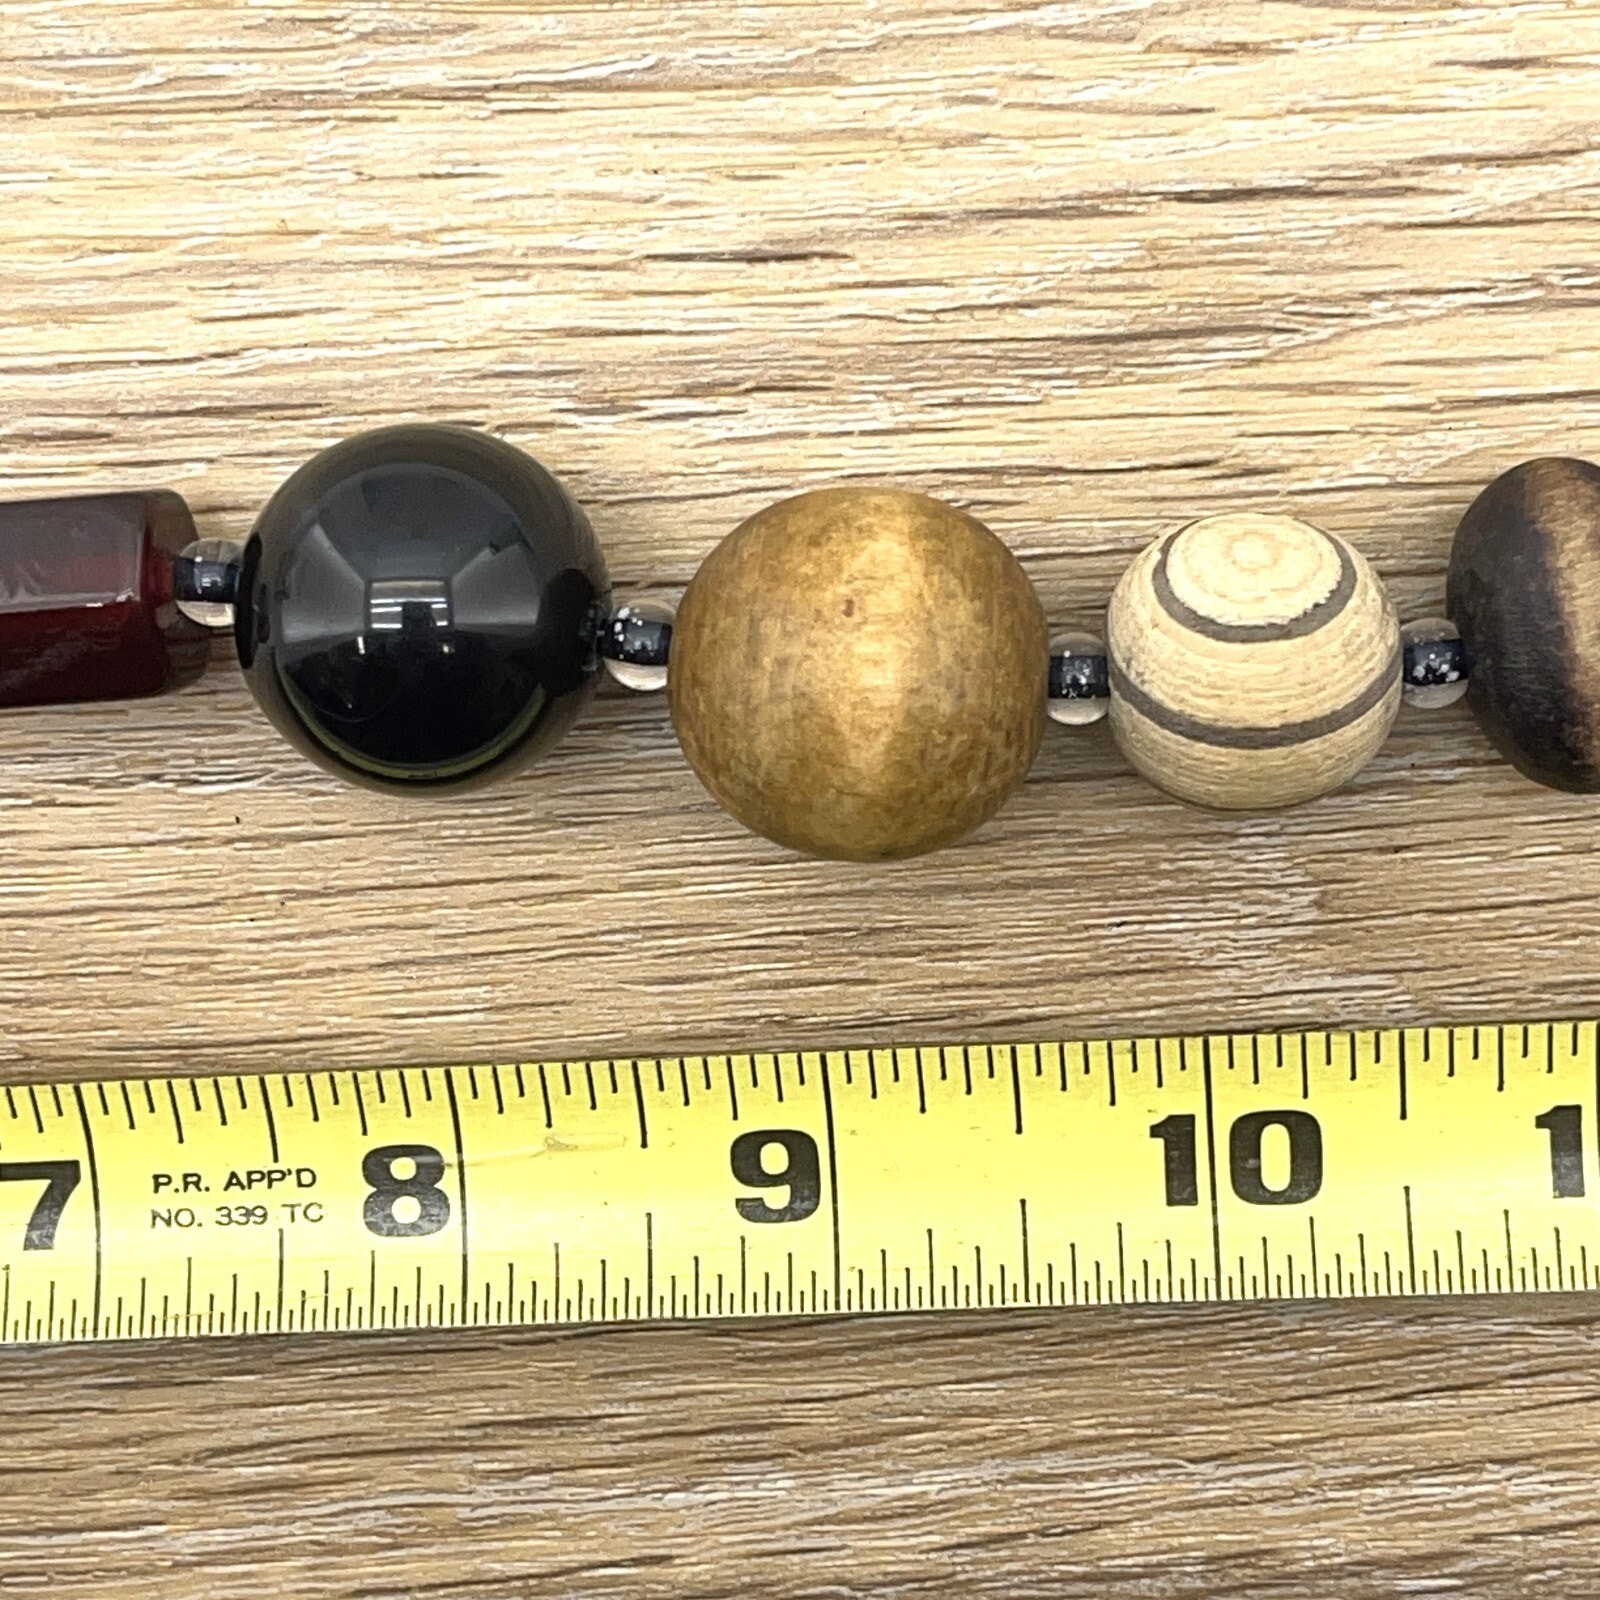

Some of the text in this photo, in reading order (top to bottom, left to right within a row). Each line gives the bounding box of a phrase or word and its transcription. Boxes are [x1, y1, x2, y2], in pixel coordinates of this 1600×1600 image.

[152, 1167, 317, 1194] P.R. APP'D
[361, 1144, 451, 1238] 8
[730, 1129, 822, 1224] 9
[1149, 1109, 1323, 1207] 10
[0, 1160, 81, 1251] 7
[150, 1201, 324, 1229] NO. 339 TC
